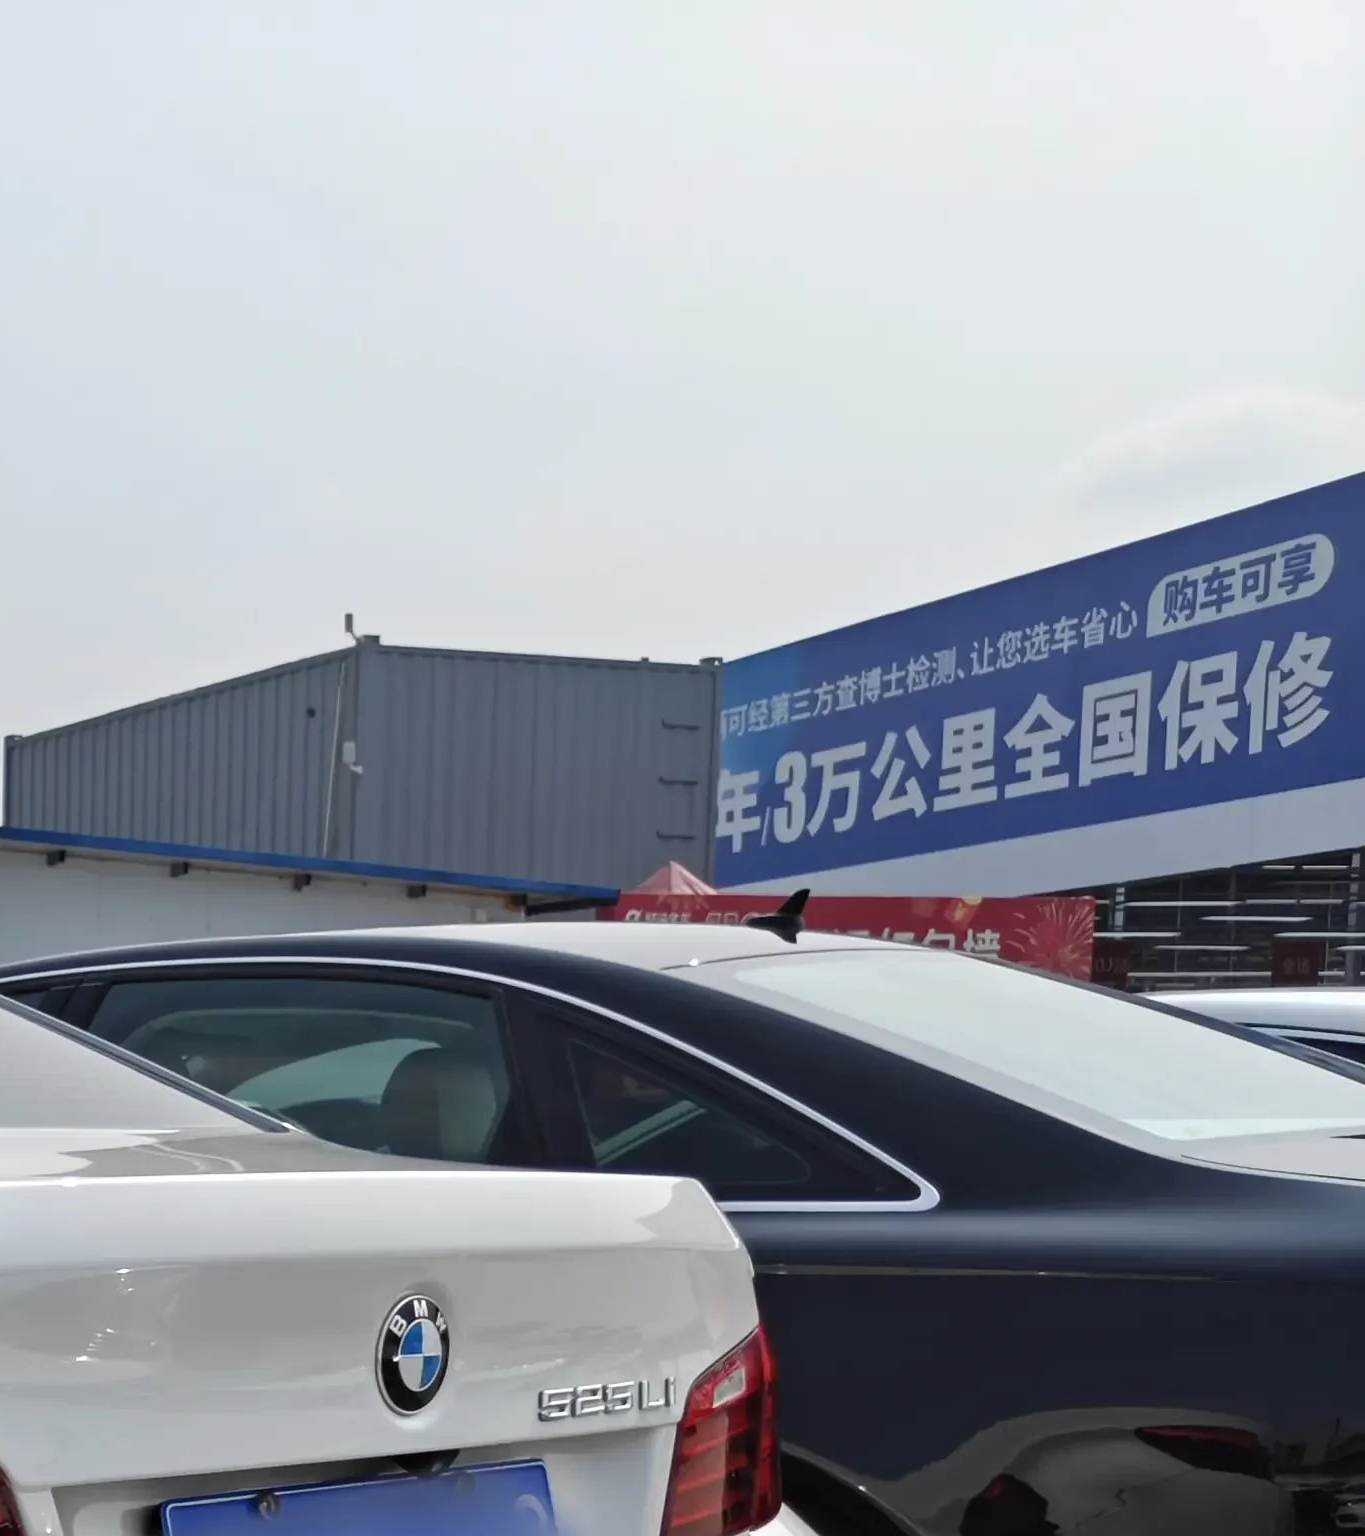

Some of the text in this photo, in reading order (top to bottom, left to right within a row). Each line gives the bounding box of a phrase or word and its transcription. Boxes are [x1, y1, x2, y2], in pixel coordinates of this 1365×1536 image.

[1162, 541, 1317, 627] 购车可享
[389, 1299, 447, 1338] BMW
[538, 1376, 675, 1421] 525Li
